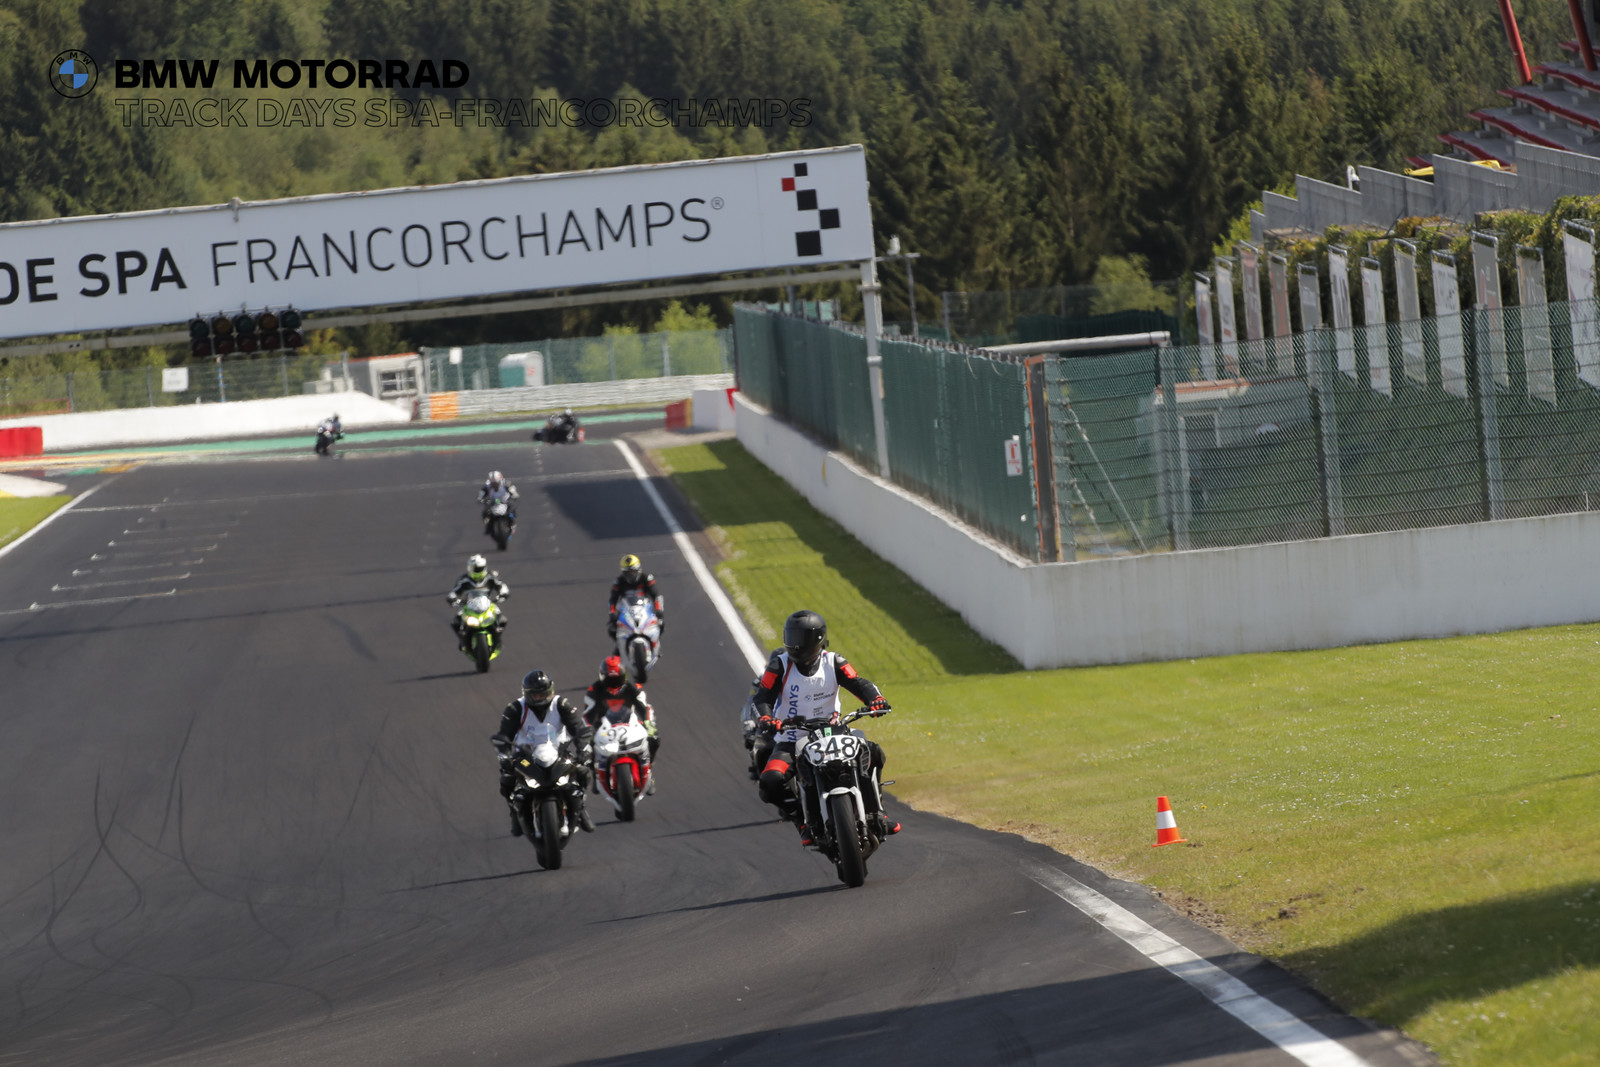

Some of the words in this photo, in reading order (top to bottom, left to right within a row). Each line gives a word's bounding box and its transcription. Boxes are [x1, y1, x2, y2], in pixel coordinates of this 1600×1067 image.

[79, 247, 188, 298] SPA
[607, 727, 628, 743] 92
[808, 736, 856, 764] 348
